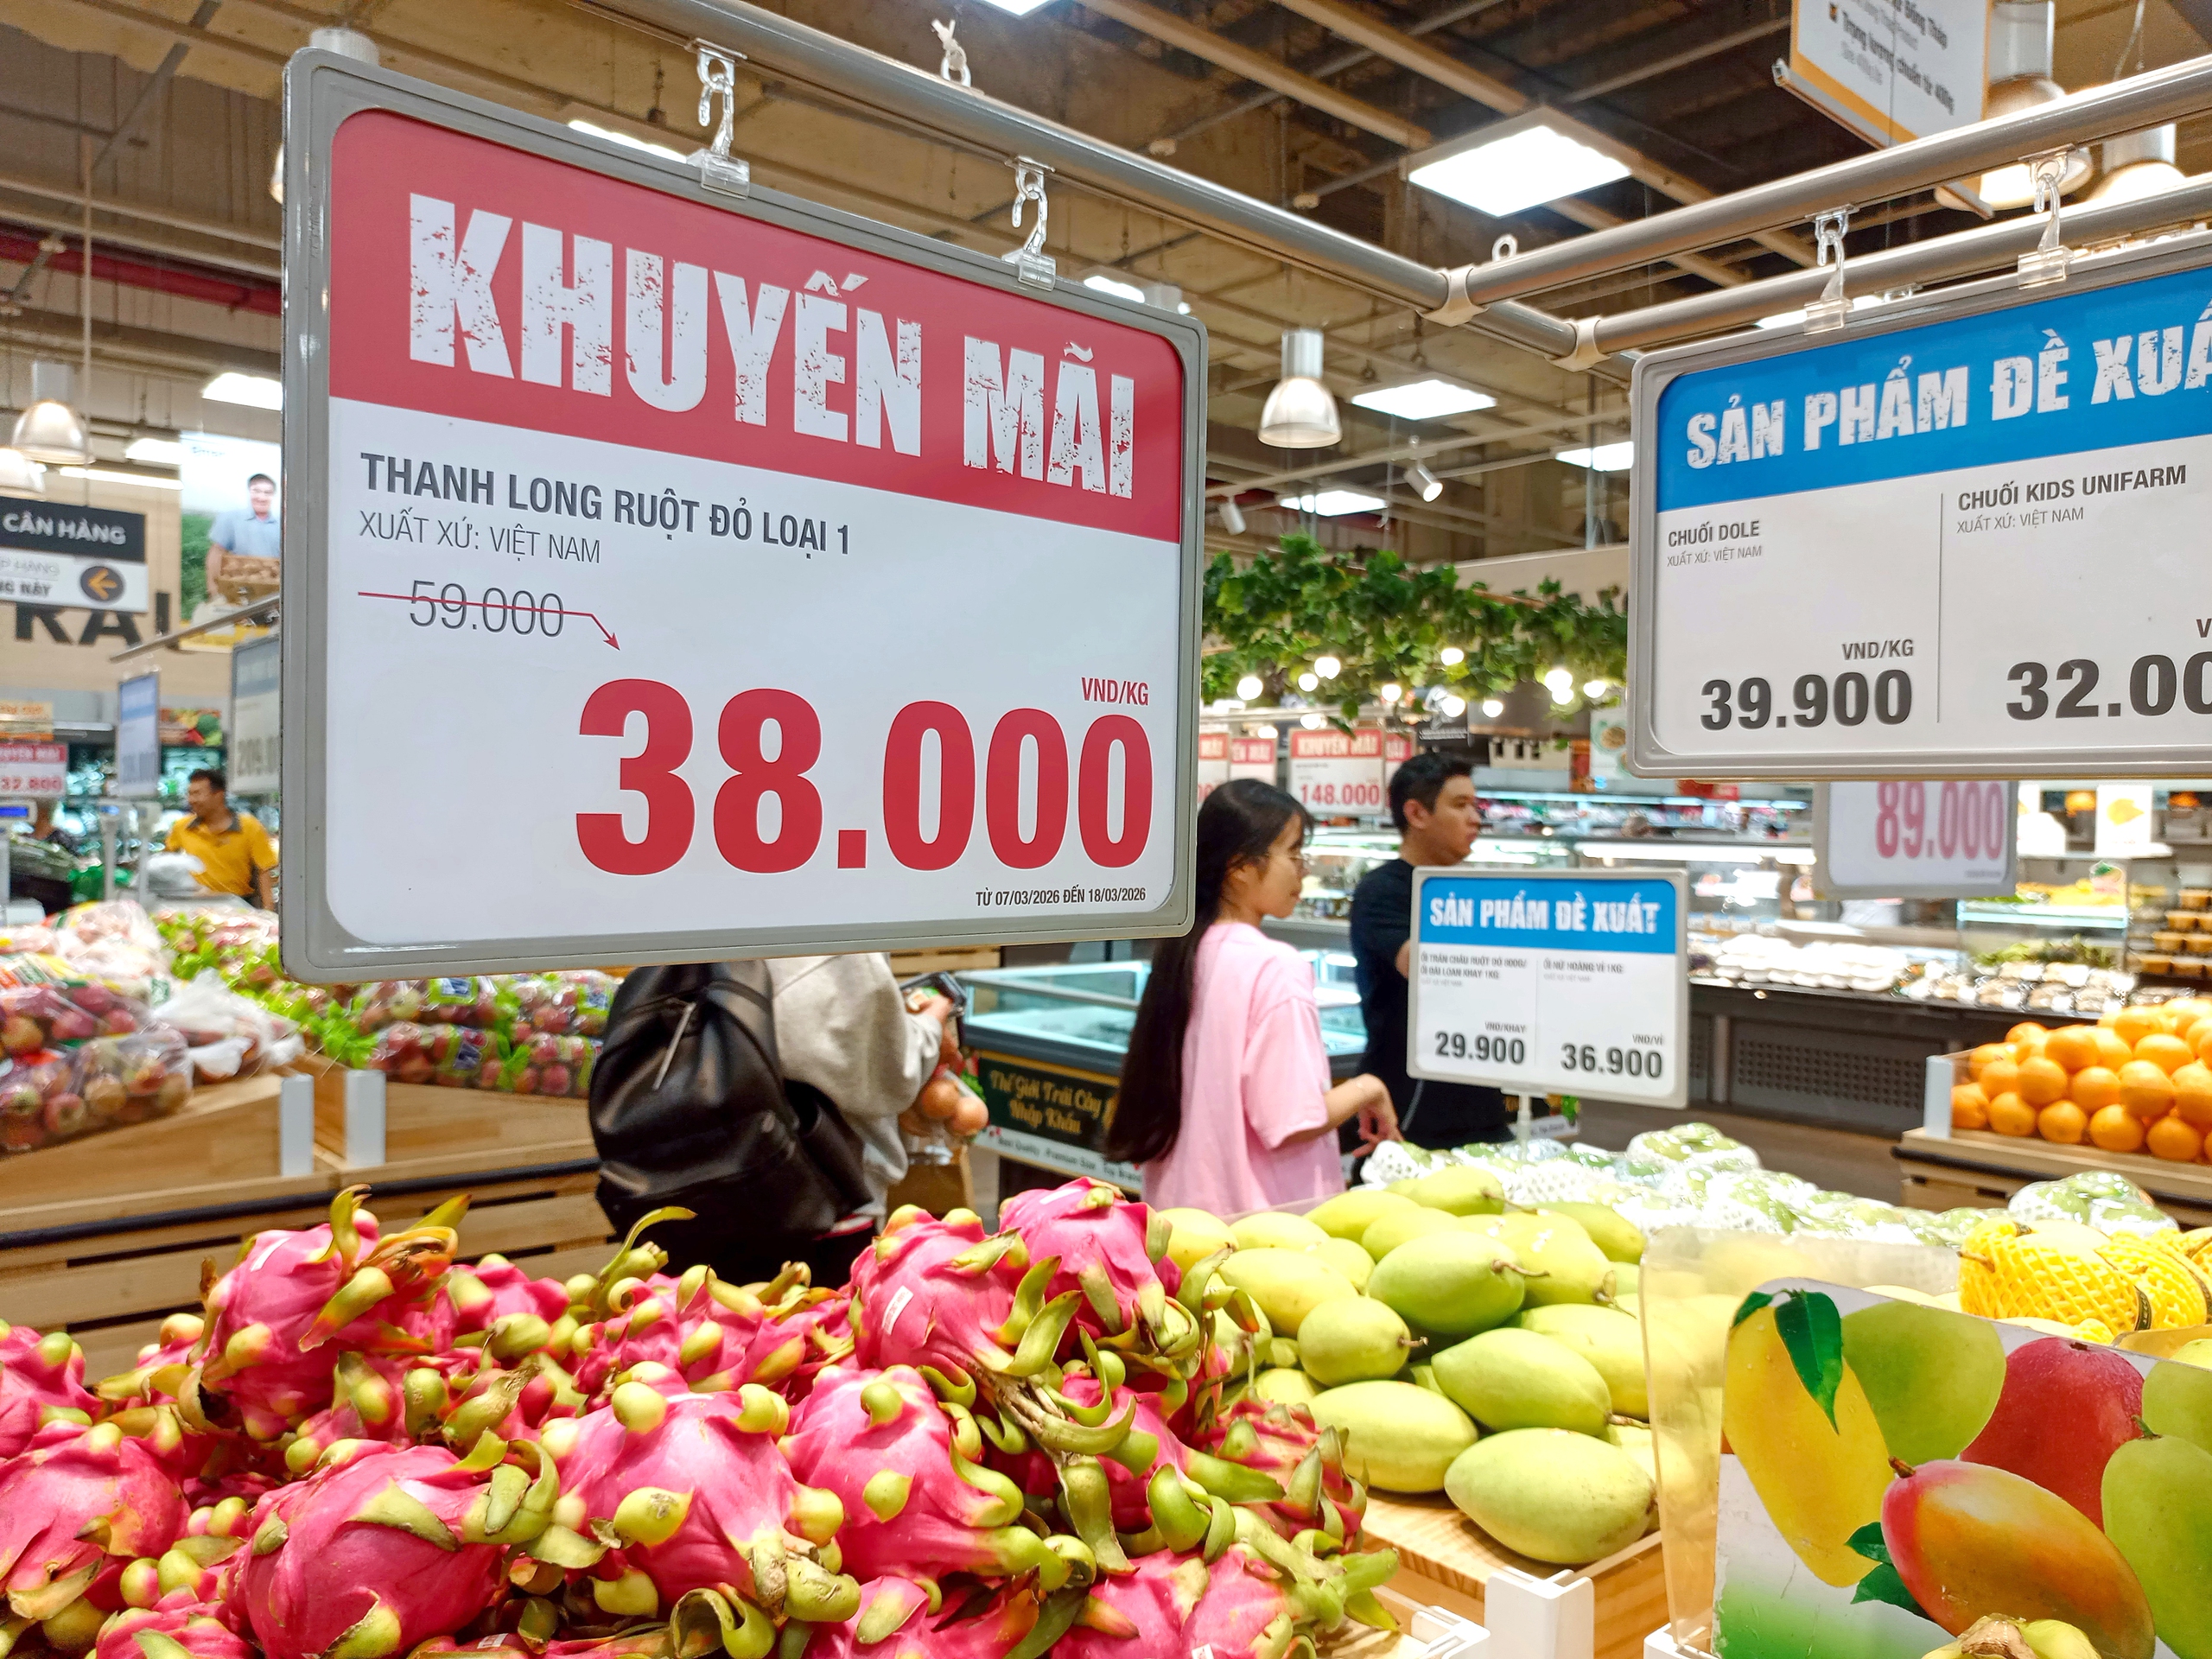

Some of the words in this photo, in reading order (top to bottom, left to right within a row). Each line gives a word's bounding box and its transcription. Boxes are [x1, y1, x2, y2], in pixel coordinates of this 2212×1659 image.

[410, 193, 921, 457] KHUYẾN
[963, 335, 1135, 499] MÃI
[1687, 392, 1784, 470] SẢN
[1803, 355, 1968, 452] PHẨM
[1990, 329, 2070, 421] ĐỀ
[1958, 480, 2018, 511] CHUỐI
[2025, 479, 2075, 503] KIDS
[2082, 464, 2187, 496] UNIFARM
[360, 452, 494, 505] THANH
[509, 474, 602, 520] LONG
[614, 488, 700, 541] RUỘT
[709, 498, 753, 540] ĐỎ
[763, 512, 827, 559] LOẠI
[836, 524, 849, 555] 1
[1957, 515, 1991, 534] XUẤT
[1993, 512, 2016, 530] XỨ:
[2019, 509, 2048, 529] VIỆT
[2052, 506, 2084, 523] NAM
[58, 518, 127, 545] HÀNG
[359, 506, 429, 543] XUẤT
[437, 516, 480, 550] XỨ:
[489, 523, 542, 562] VIỆT
[549, 535, 601, 564] NAM
[1668, 521, 1713, 547] CHUỐI
[1719, 520, 1760, 541] DOLE
[1667, 550, 1692, 567] XUẤT
[1694, 549, 1711, 563] XỨ:
[1713, 547, 1735, 563] VIỆT
[1738, 545, 1763, 559] NAM
[410, 580, 564, 638] 59.000
[1841, 639, 1914, 661] VND/KG
[1080, 677, 1149, 706] VND/KG
[1700, 669, 1912, 731] 39.900
[575, 678, 1153, 875] 38.000
[1300, 784, 1381, 805] 148.000
[1876, 781, 2005, 859] 89.000
[976, 887, 993, 906] TỪ
[995, 889, 1059, 906] 07/03/2026
[1063, 884, 1085, 903] ĐẾN
[1089, 887, 1146, 903] 18/03/2026
[1430, 891, 1473, 927] SẢN
[1480, 889, 1549, 930] PHẨM
[1554, 890, 1586, 931] ĐỀ
[1592, 892, 1661, 934] XUẤT
[1442, 968, 1461, 977] LOAN
[1463, 969, 1482, 979] KHAY
[1567, 959, 1594, 973] HOÀNG
[1484, 1021, 1526, 1033] VND/KHAY
[1434, 1031, 1525, 1065] 29.900
[1560, 1042, 1663, 1078] 36.900
